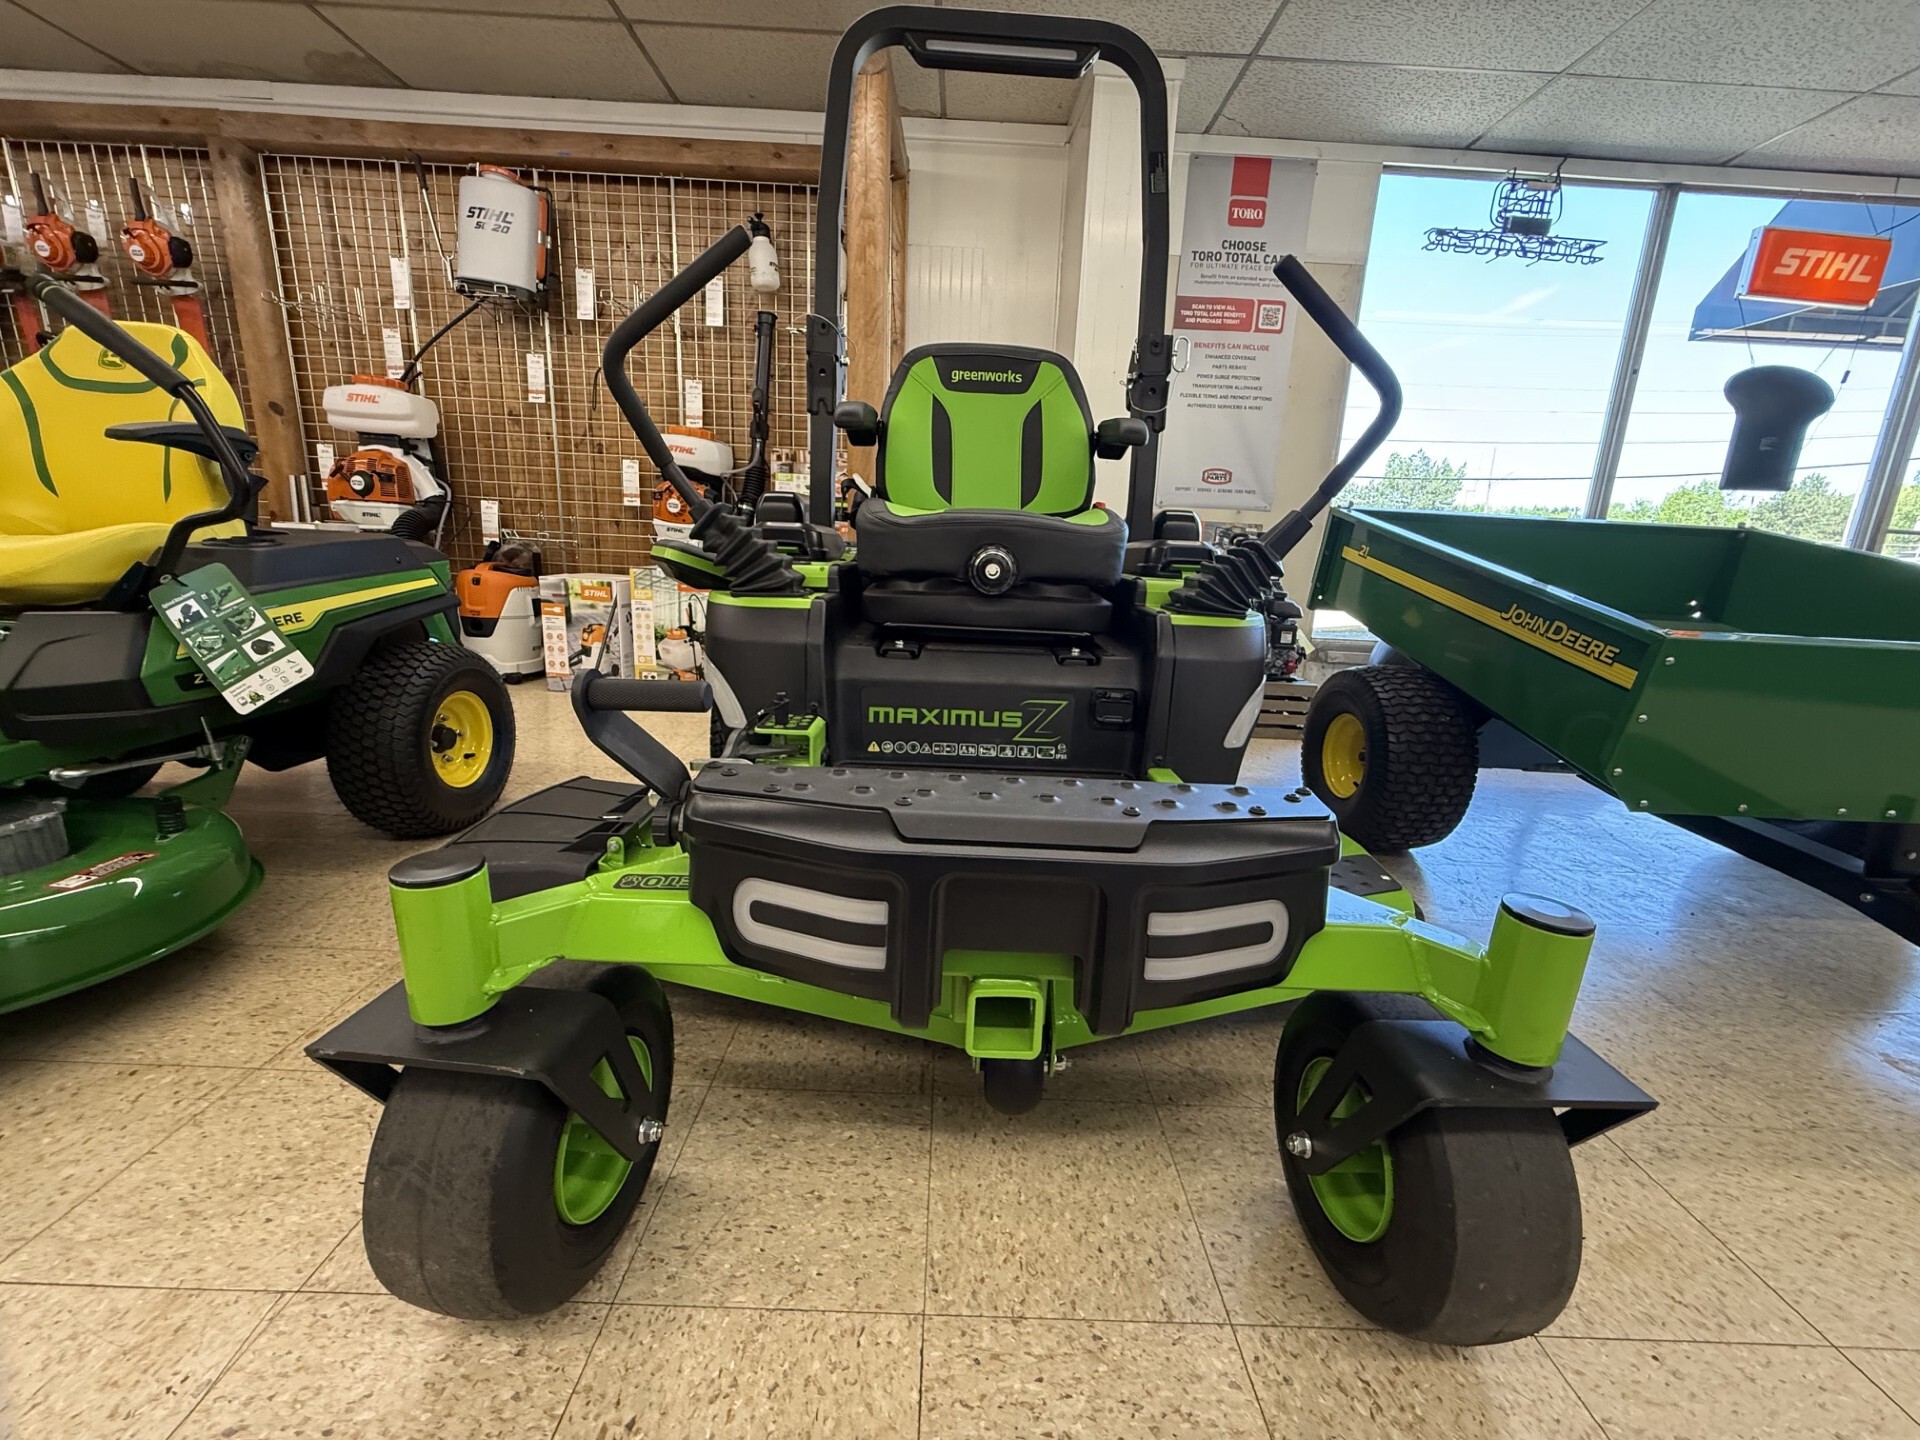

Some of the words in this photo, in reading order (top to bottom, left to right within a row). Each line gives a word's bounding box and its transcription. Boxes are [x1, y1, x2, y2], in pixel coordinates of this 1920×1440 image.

[466, 206, 512, 224] STIHL
[1232, 208, 1262, 220] TORO
[492, 224, 510, 234] 20
[1222, 240, 1267, 252] CHOOSE
[1192, 250, 1222, 262] TORO
[1225, 252, 1260, 264] TOTAL
[1772, 248, 1873, 283] STIHL
[1194, 342, 1226, 350] BENEFITS
[951, 370, 1022, 383] greenworks
[346, 393, 379, 404] STIHL
[668, 444, 695, 455] STIHL
[1358, 545, 1370, 558] 21
[583, 589, 608, 598] STIHL
[272, 612, 304, 626] ERE
[868, 706, 1023, 728] MAXIMUS
